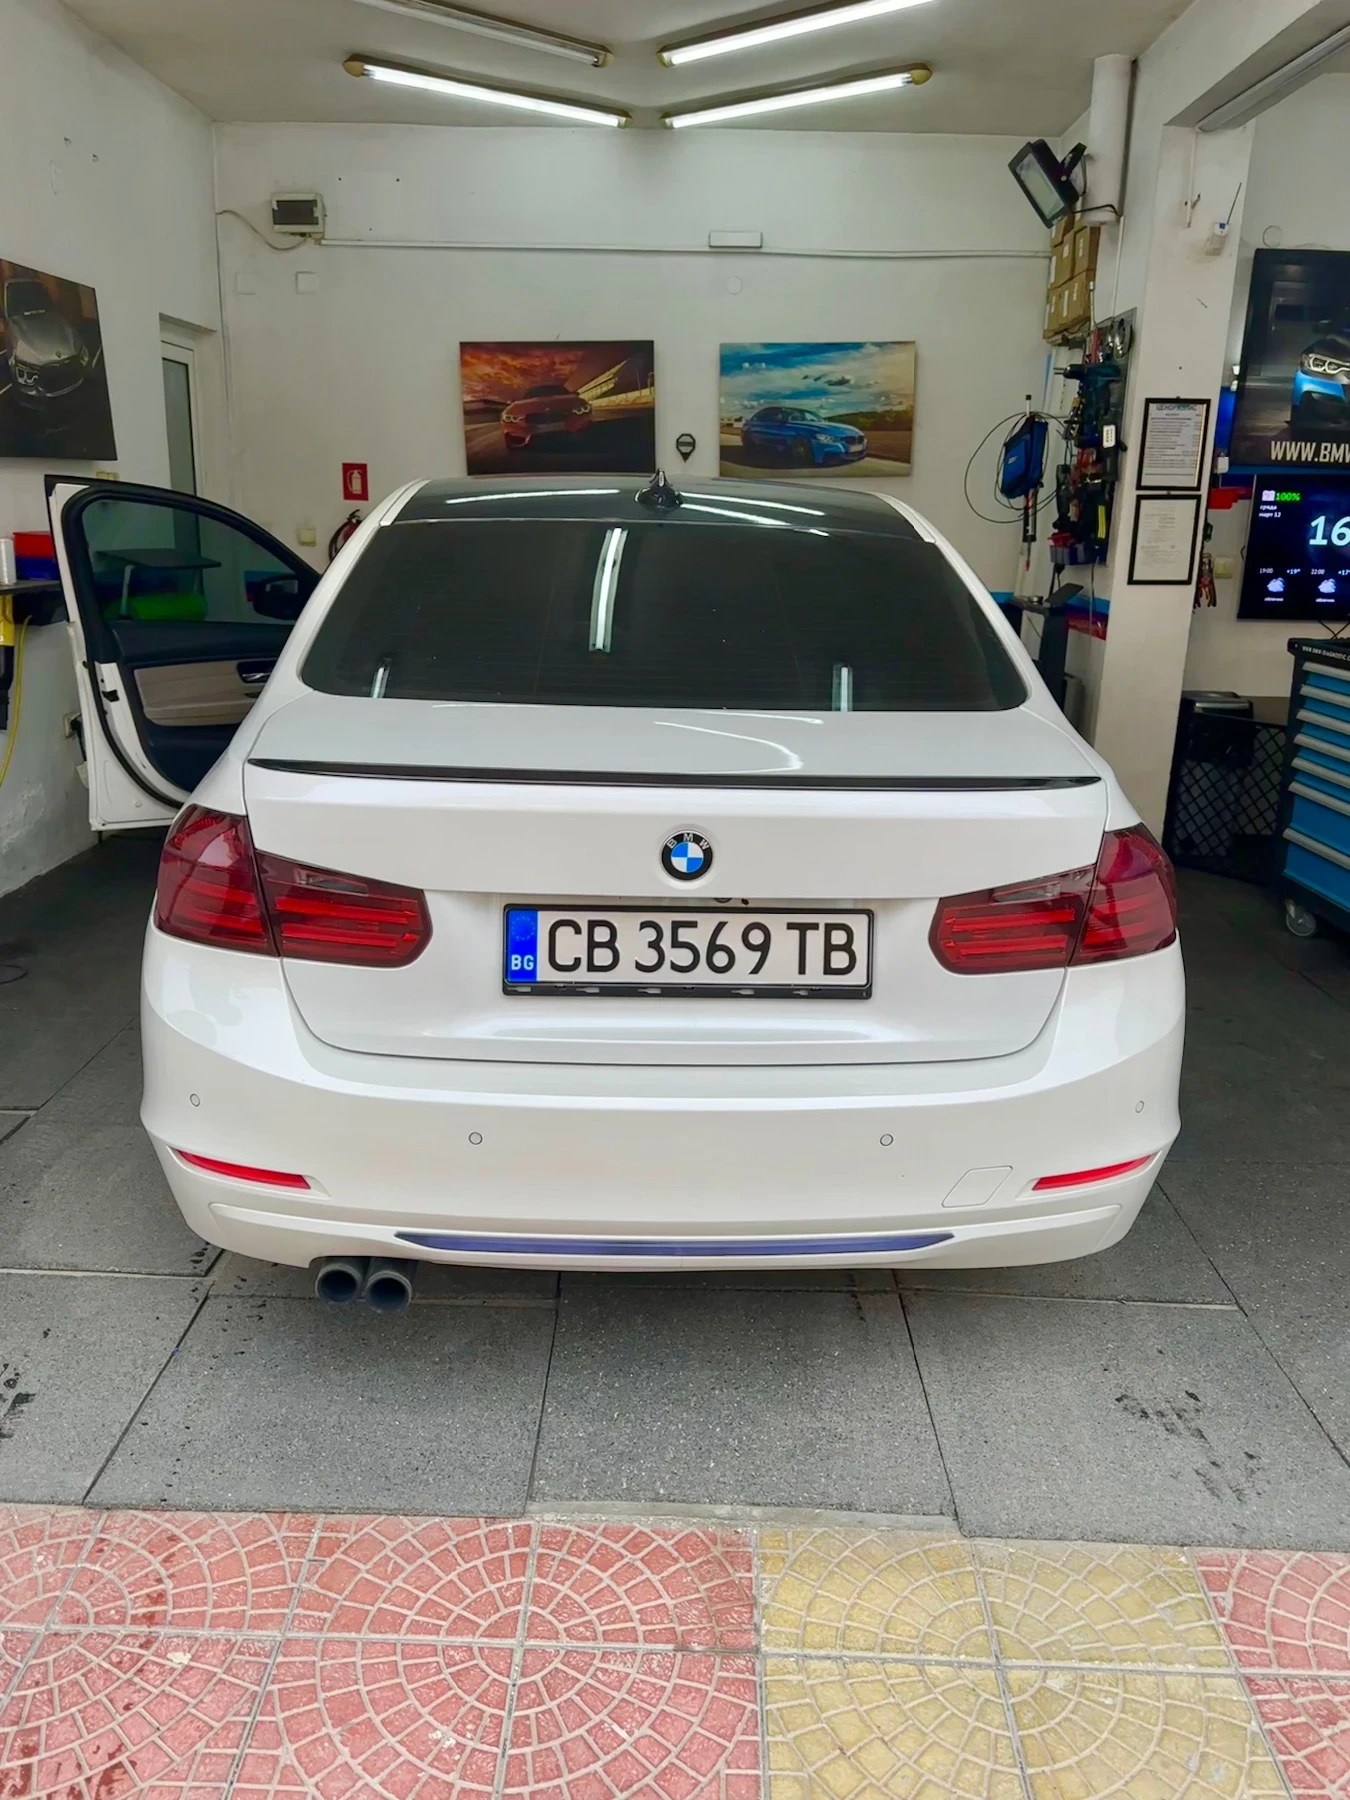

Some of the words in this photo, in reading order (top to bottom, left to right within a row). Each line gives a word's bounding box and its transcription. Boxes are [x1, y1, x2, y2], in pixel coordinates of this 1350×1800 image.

[1276, 492, 1300, 501] 100%
[666, 833, 710, 850] BMW
[548, 919, 620, 972] CB
[635, 921, 771, 974] 3569
[786, 922, 857, 976] TB
[511, 955, 534, 971] BG
